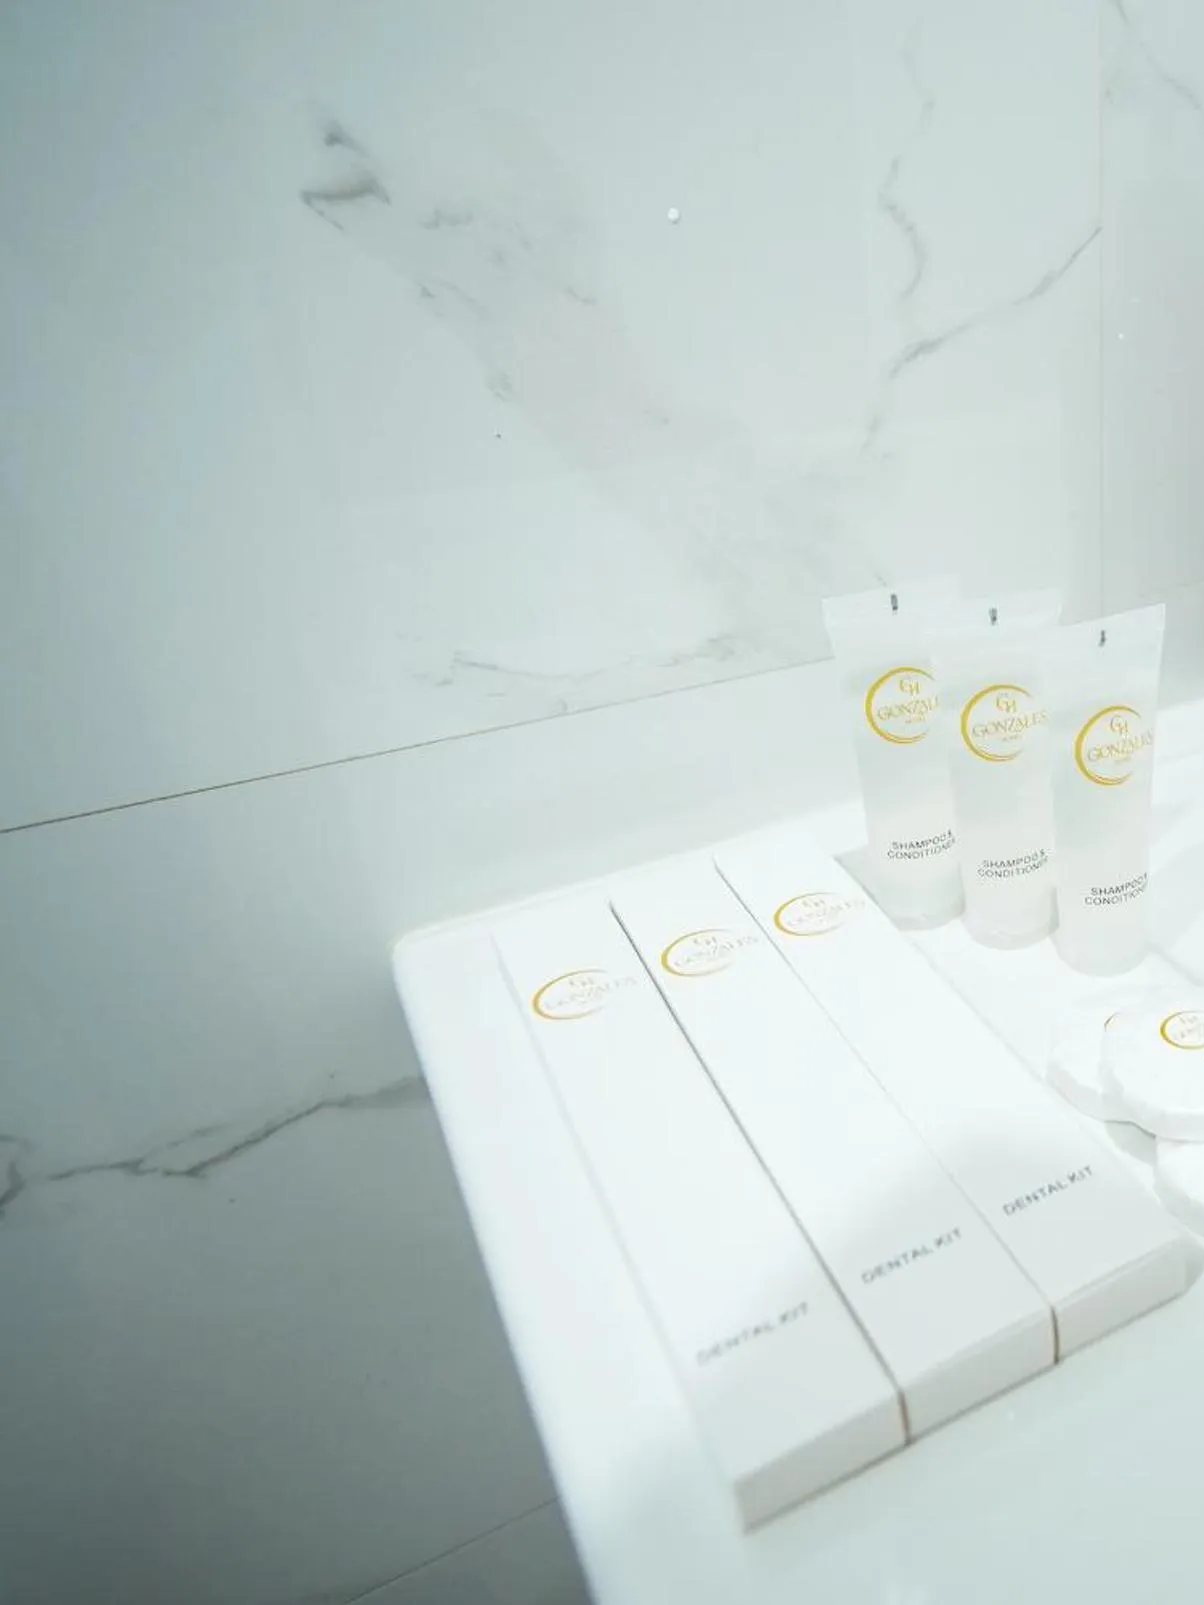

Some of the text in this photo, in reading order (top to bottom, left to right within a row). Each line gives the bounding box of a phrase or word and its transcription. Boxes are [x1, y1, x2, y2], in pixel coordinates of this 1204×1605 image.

[972, 709, 1048, 737] GONZALES
[892, 834, 947, 851] SHAMPOO
[983, 852, 1039, 868] SHAMPOO
[1090, 875, 1144, 897] SHAMPOO
[1002, 1165, 1094, 1217] DENTAL KIT
[861, 1227, 963, 1285] DENTAL KIT
[697, 1301, 810, 1366] DENTAL KIT
